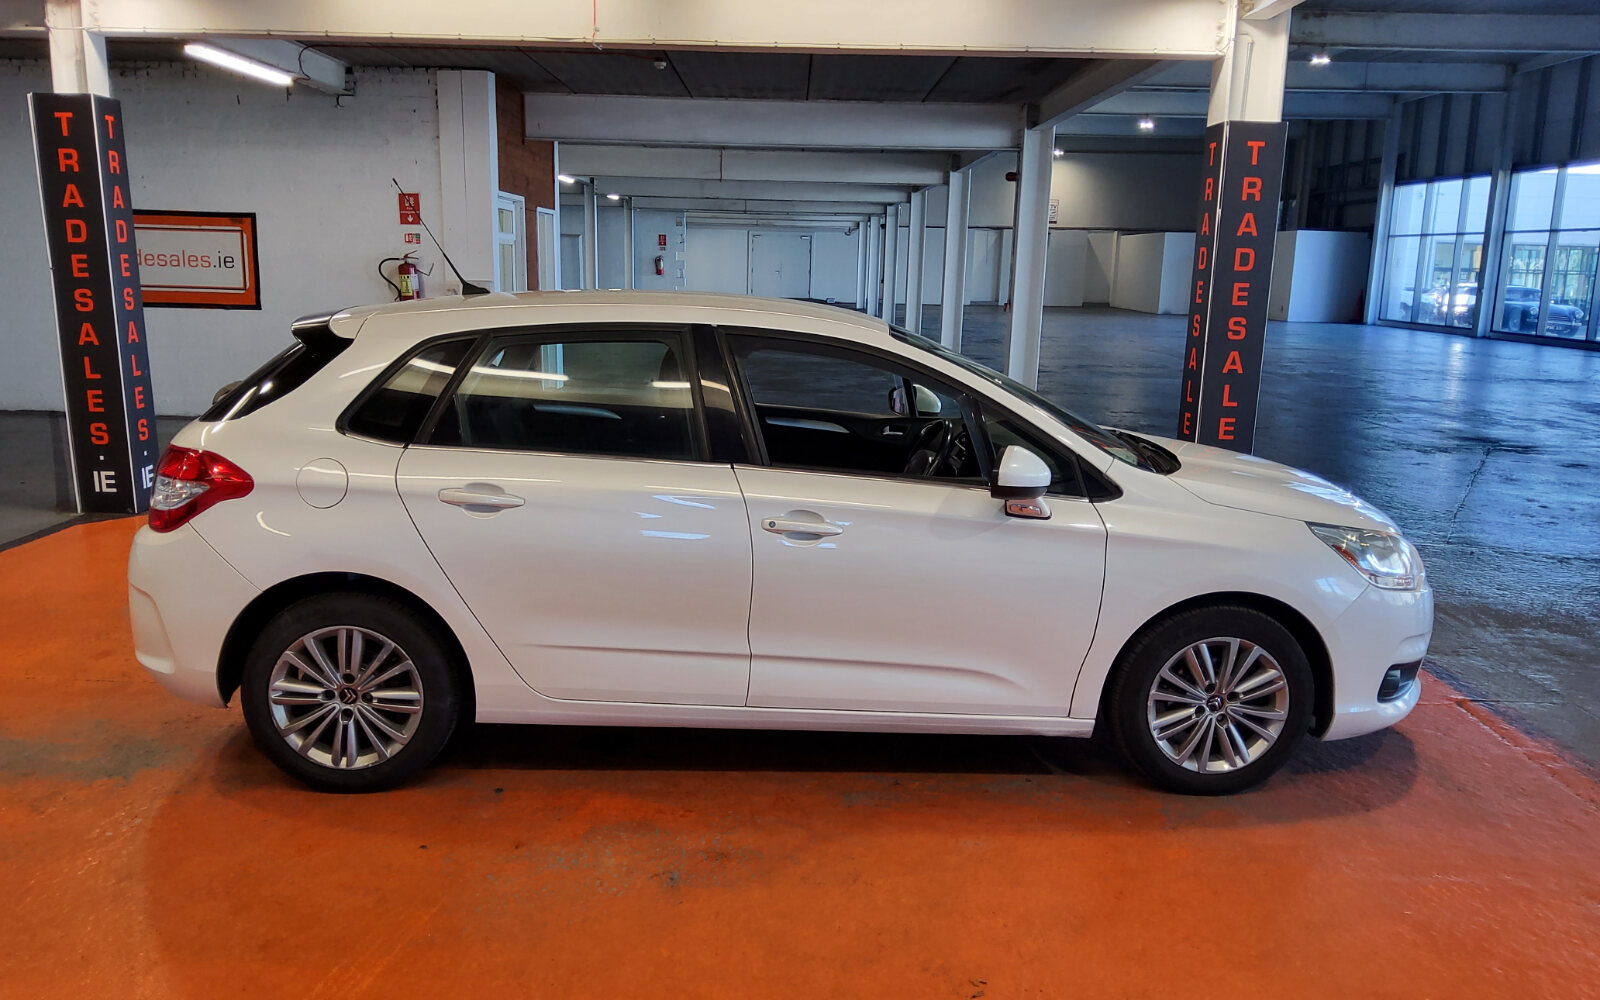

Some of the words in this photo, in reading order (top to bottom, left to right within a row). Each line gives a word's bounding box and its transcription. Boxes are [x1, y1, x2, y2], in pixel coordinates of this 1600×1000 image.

[54, 111, 117, 493] TRADESALES.IE
[1183, 141, 1217, 435] TRADESALE
[1218, 140, 1266, 440] TRADESALE
